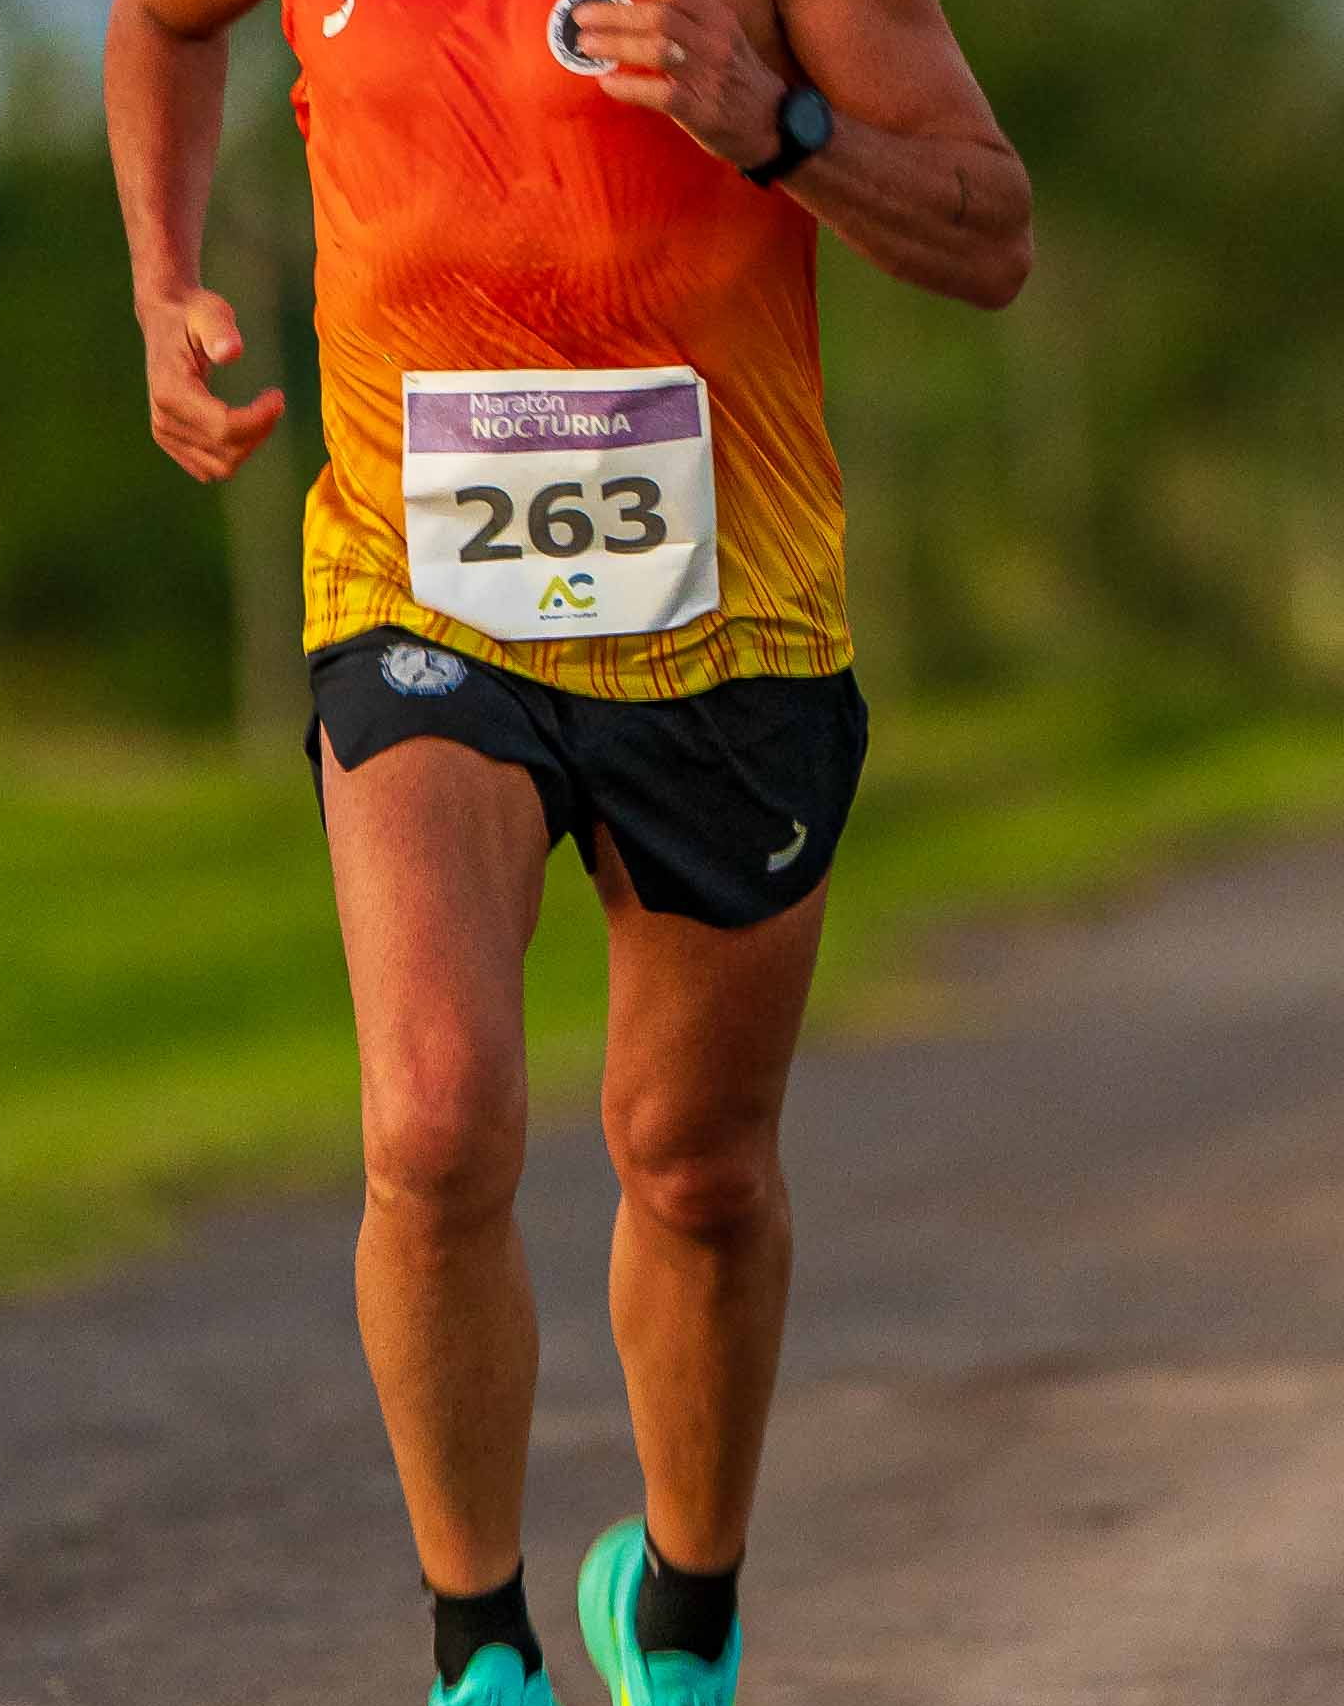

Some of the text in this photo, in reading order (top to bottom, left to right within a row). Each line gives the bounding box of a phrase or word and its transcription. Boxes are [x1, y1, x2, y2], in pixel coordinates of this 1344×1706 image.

[470, 391, 567, 415] Maratón
[470, 413, 632, 440] NOCTURNA
[456, 476, 667, 563] 263
